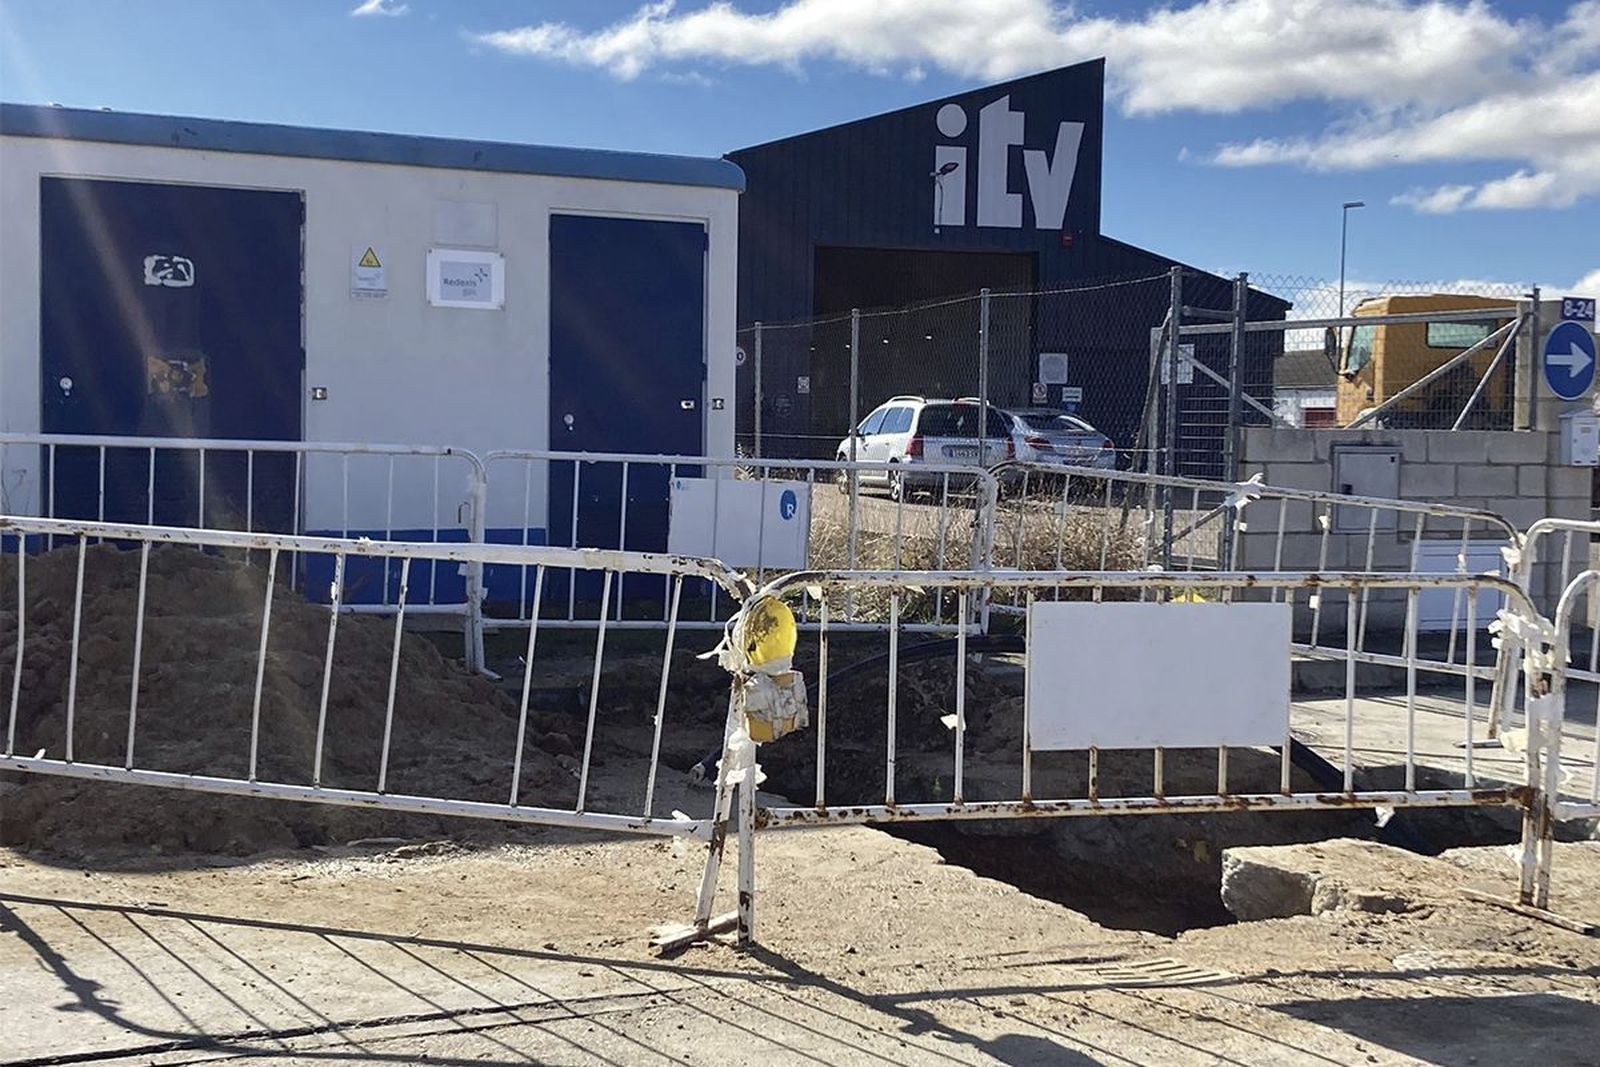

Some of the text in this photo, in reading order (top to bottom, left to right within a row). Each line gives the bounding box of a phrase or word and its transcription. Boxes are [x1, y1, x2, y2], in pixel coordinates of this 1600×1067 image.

[934, 95, 1085, 230] itv
[443, 278, 477, 288] Redexis
[1564, 300, 1594, 318] 8-24
